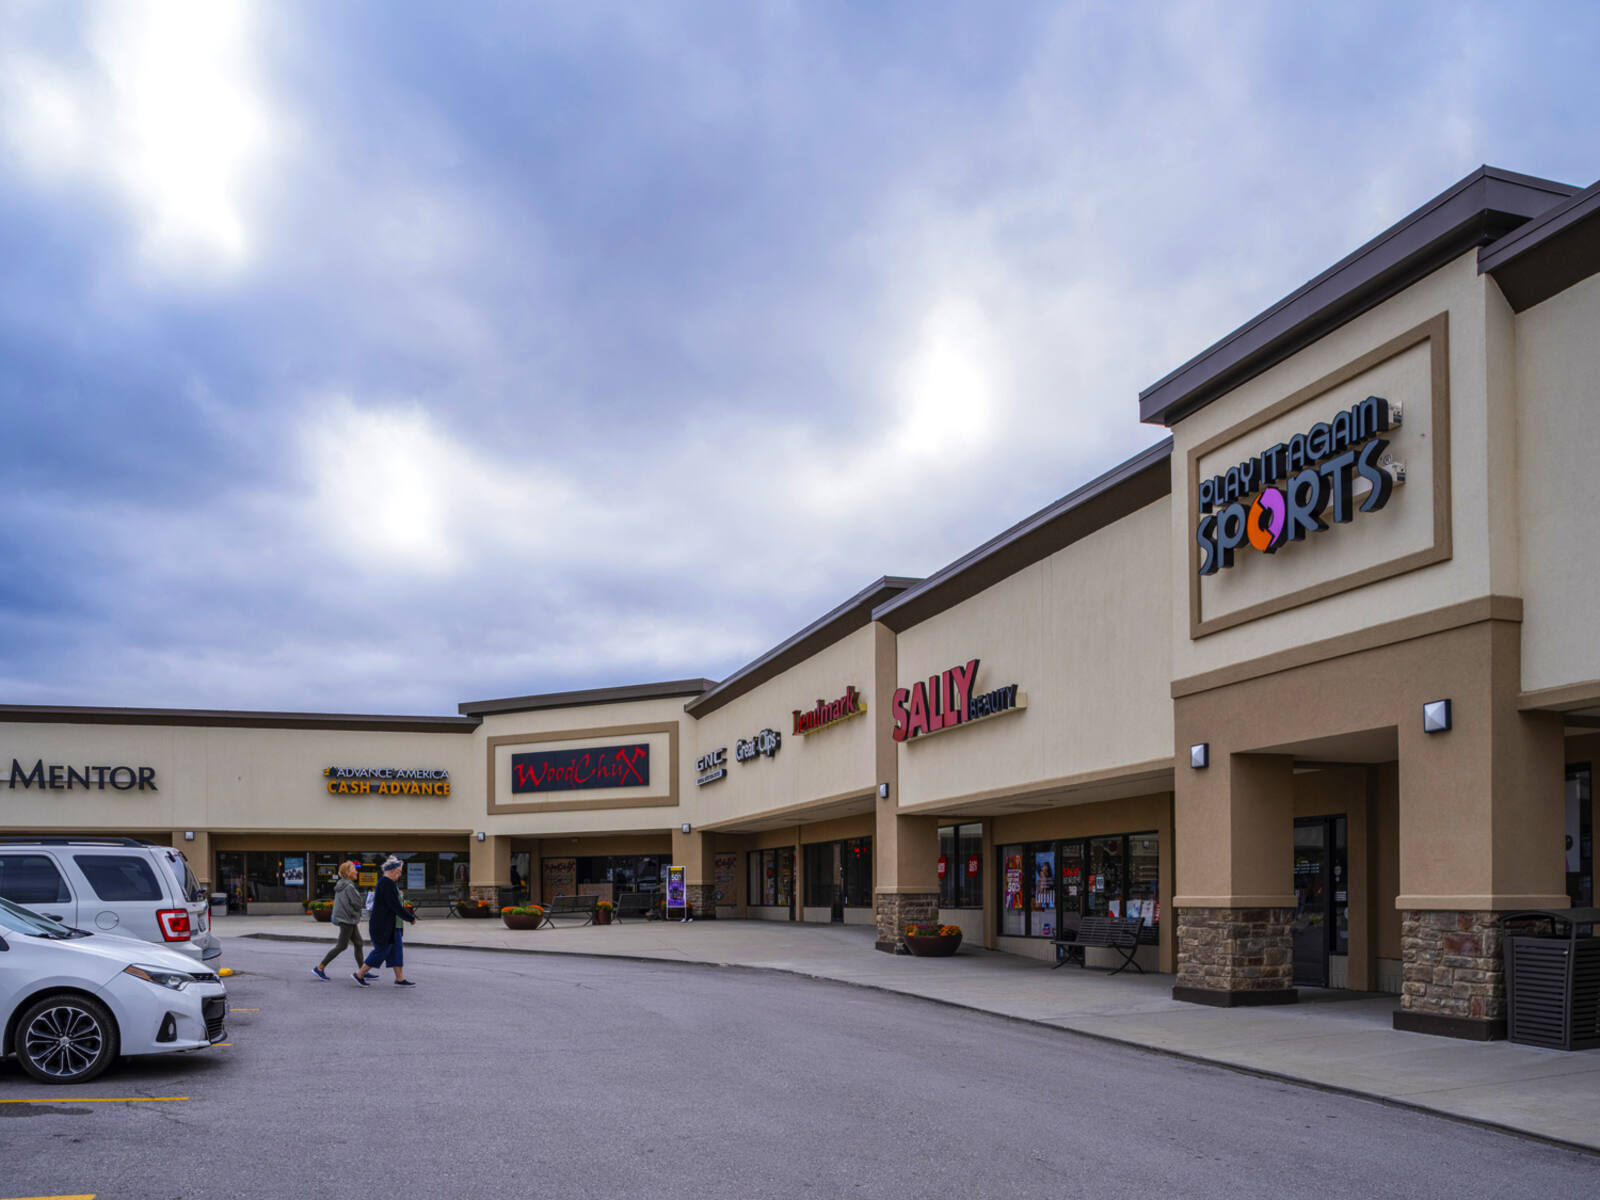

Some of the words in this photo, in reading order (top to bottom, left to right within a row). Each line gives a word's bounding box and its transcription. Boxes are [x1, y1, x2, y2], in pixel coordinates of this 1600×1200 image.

[1199, 456, 1260, 513] PLAY
[1260, 442, 1288, 484] IT
[1287, 396, 1389, 472] AGAIN
[1197, 439, 1392, 576] SPORTS
[892, 658, 980, 742] SALLY
[969, 683, 1018, 720] BEAUTY
[695, 747, 727, 772] GNC
[736, 738, 757, 762] Great
[9, 758, 158, 791] MENTOR
[336, 767, 393, 778] ADVANCE
[396, 768, 449, 779] AMERICA
[327, 780, 371, 795] CASH
[378, 781, 451, 796] ADVANCE
